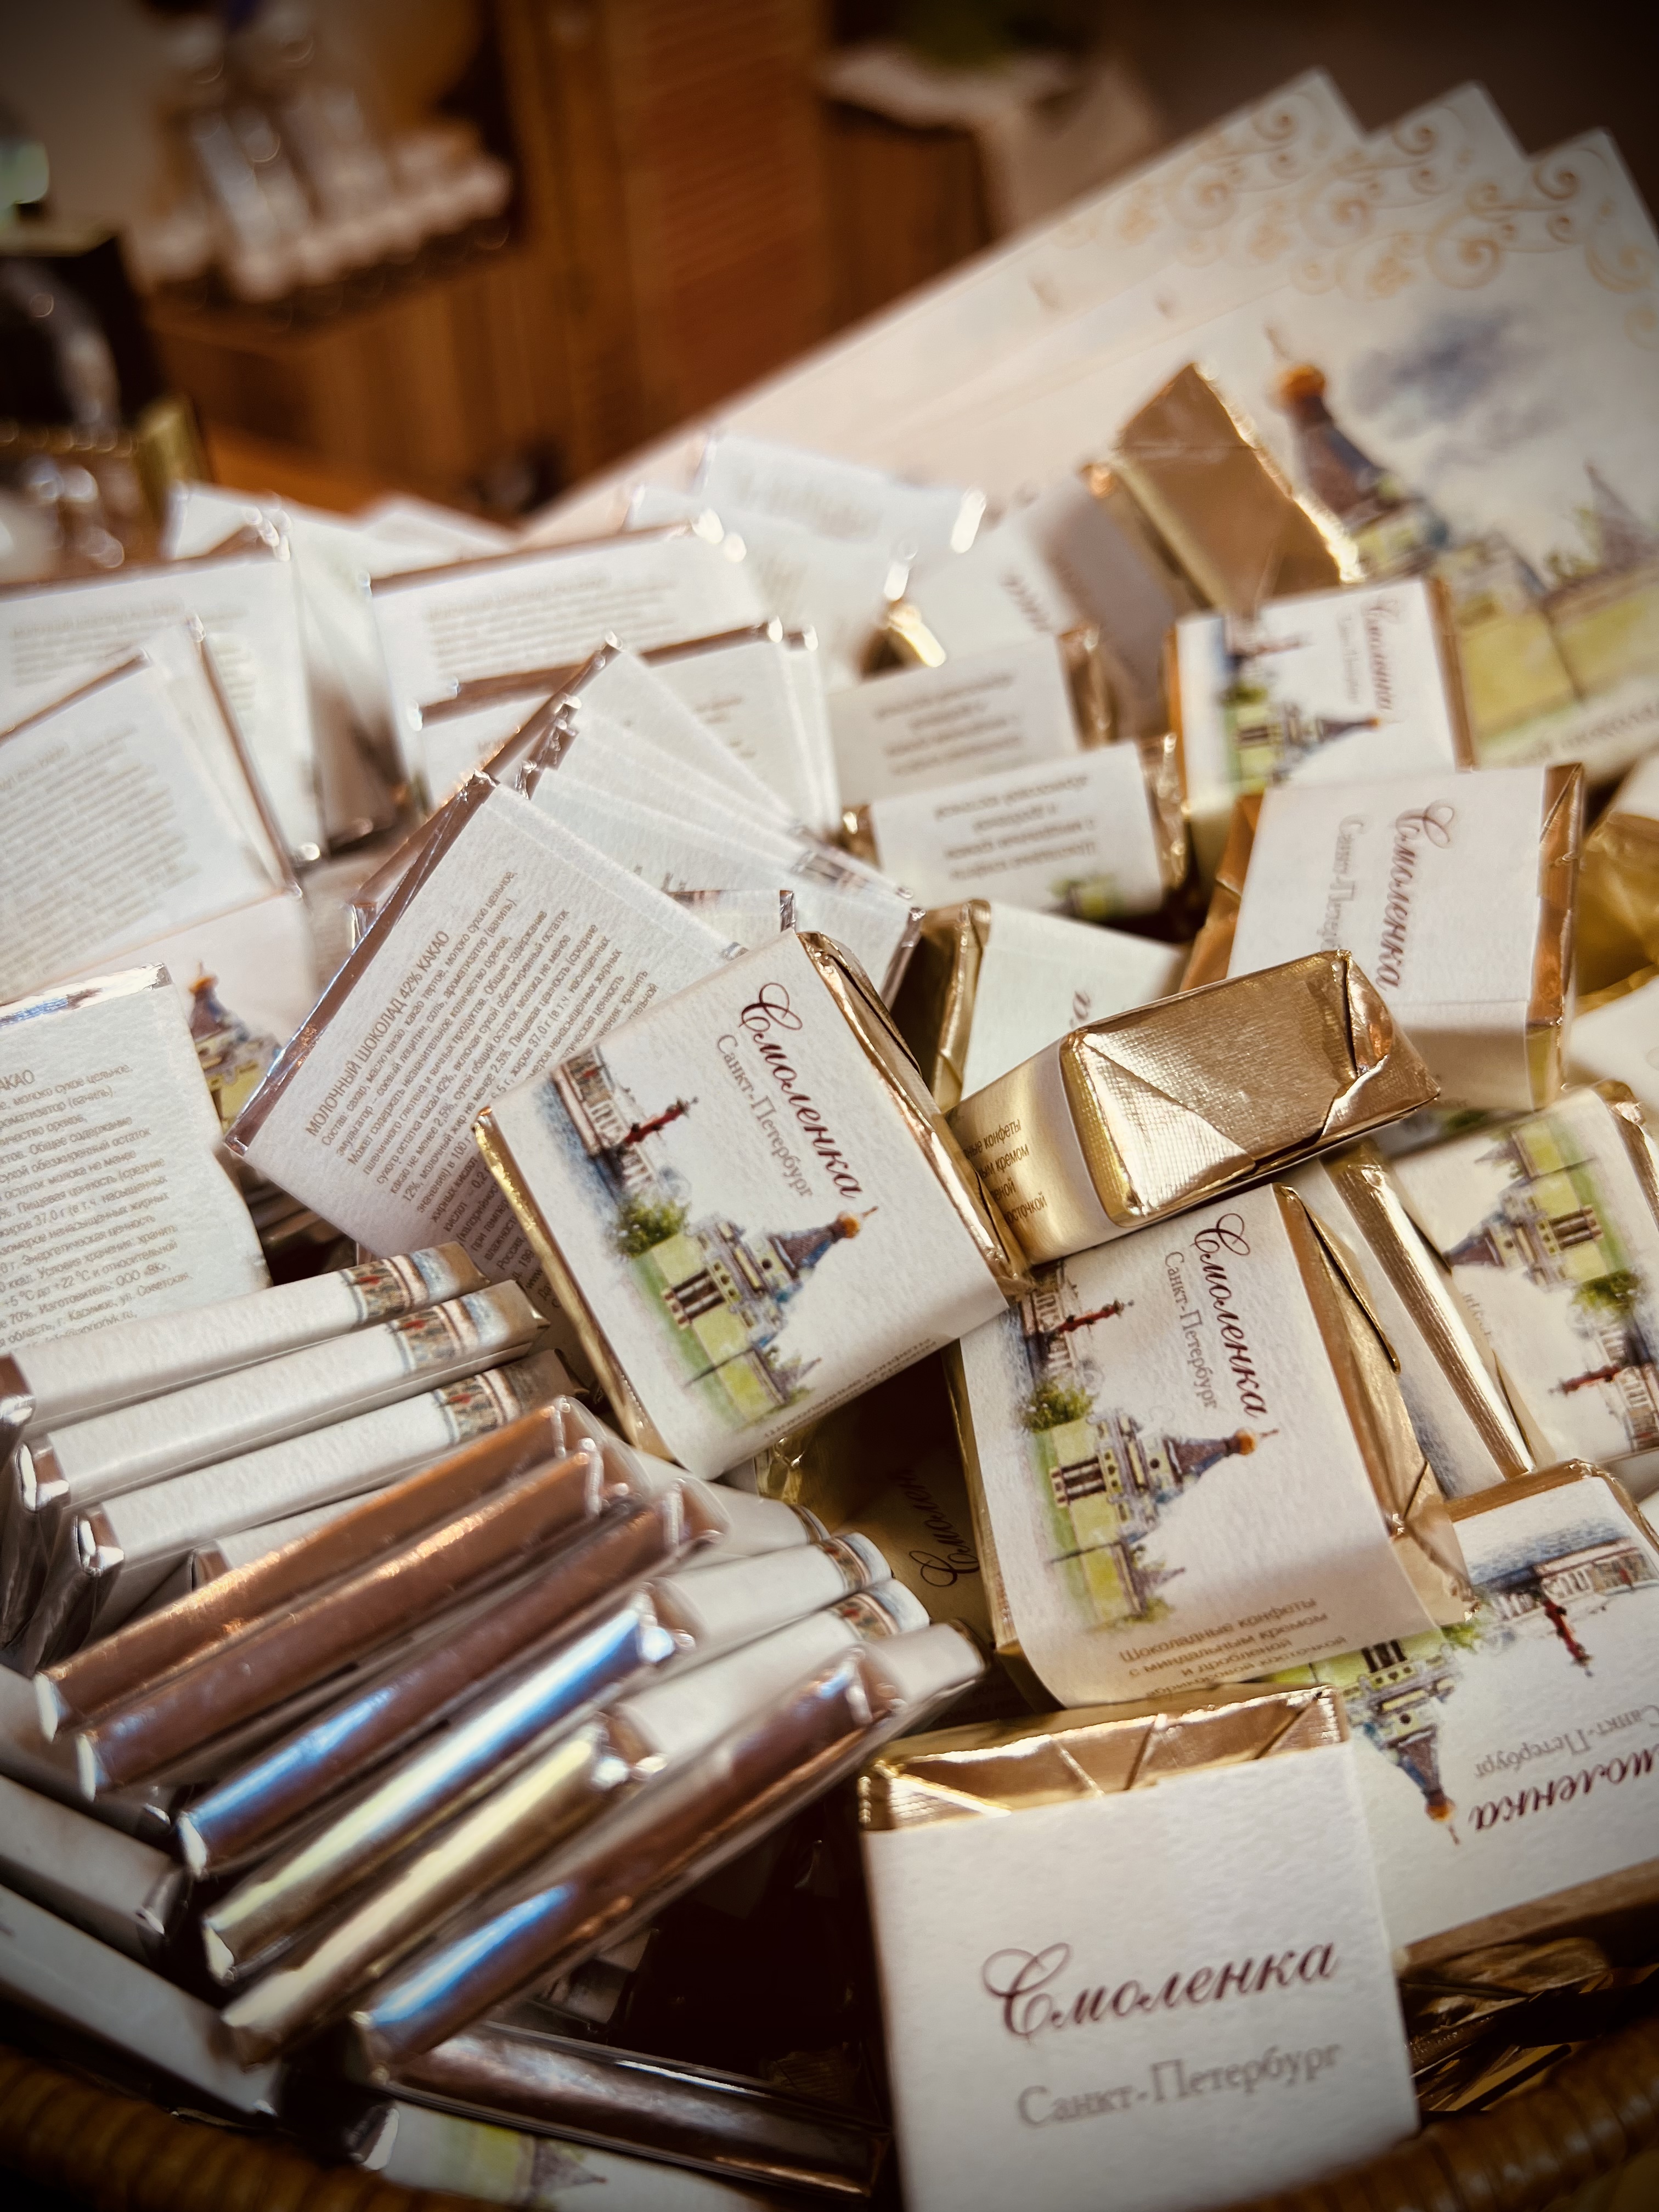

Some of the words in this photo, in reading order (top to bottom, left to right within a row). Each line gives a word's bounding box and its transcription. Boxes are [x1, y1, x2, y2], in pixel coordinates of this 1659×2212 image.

[1375, 799, 1455, 991] Смоленка
[306, 1060, 361, 1136] МОЛОЧНЫЙ
[355, 998, 406, 1062] ШОКОЛАД
[399, 972, 422, 998] 42%
[416, 930, 449, 972] КАКАО
[321, 1111, 348, 1146] Состав:
[346, 1085, 370, 1111] сахар,
[365, 1054, 387, 1083] масло
[404, 1000, 424, 1025] какао
[421, 969, 448, 999] тертое,
[444, 933, 470, 967] молоко
[467, 908, 488, 933] сухое
[485, 871, 517, 908] цельное,
[336, 1105, 373, 1156] эмульгатор
[376, 1062, 402, 1096] соевый
[399, 1025, 430, 1063] лецитин,
[426, 1001, 448, 1023] соль,
[443, 936, 488, 998] ароматизатор
[347, 1135, 373, 1165] Может
[370, 1089, 405, 1134] содержать
[402, 1018, 452, 1087] незначительное
[450, 968, 486, 1018] количество
[484, 936, 512, 968] орехов,
[363, 1121, 402, 1175] пшеничного
[399, 1084, 427, 1121] глютена
[424, 1076, 433, 1084] и
[429, 1043, 455, 1076] яичных
[483, 963, 510, 995] Общее
[507, 911, 546, 963] содержание
[376, 1154, 400, 1184] сухого
[396, 1120, 422, 1155] остатка
[419, 1094, 439, 1120] какао
[453, 1034, 482, 1071] включая
[478, 1007, 500, 1034] сухой
[497, 943, 544, 1007] обезжиренный
[541, 909, 569, 943] остаток
[390, 1168, 410, 1194] какао
[406, 1155, 419, 1169] не
[415, 1126, 438, 1155] менее
[453, 1074, 474, 1100] сухой
[471, 1043, 495, 1074] общий
[492, 1008, 519, 1043] остаток
[516, 976, 543, 1009] молока
[539, 963, 551, 977] не
[548, 934, 571, 963] менее
[510, 1047, 533, 1076] жиров
[568, 936, 610, 992] насыщенных
[549, 984, 597, 1049] ненасыщенных
[594, 949, 622, 985] жирных
[592, 975, 624, 1015] ценность
[419, 1133, 453, 1179] молочный
[450, 1114, 466, 1135] жир
[463, 1102, 476, 1115] не
[472, 1073, 495, 1102] менее
[508, 1006, 541, 1047] Пищевая
[539, 967, 570, 1006] ценность
[717, 1034, 814, 1196] Санкт-Петербург
[739, 982, 862, 1199] Смоленка
[984, 1119, 1021, 1149] конфеты
[431, 1187, 458, 1222] жирных
[454, 1157, 480, 1188] кислот
[447, 1160, 455, 1169] в
[451, 1142, 467, 1159] 100
[456, 1182, 498, 1242] (калорийнос
[996, 1144, 1029, 1173] кремом
[1165, 1251, 1217, 1409] Санкт-Петербург
[1189, 1213, 1267, 1418] Смоленка
[1120, 1623, 1234, 1662] Шоколадные
[1237, 1598, 1317, 1628] конфеты
[1144, 1634, 1255, 1673] миндальным
[1259, 1612, 1328, 1640] кремом
[1181, 1668, 1194, 1677] и
[1198, 1638, 1293, 1673] дробленой
[1470, 1743, 1659, 1831] моленка
[981, 1942, 1340, 2042] Смоленка
[1017, 2044, 1340, 2128] Санкт-Петербург
